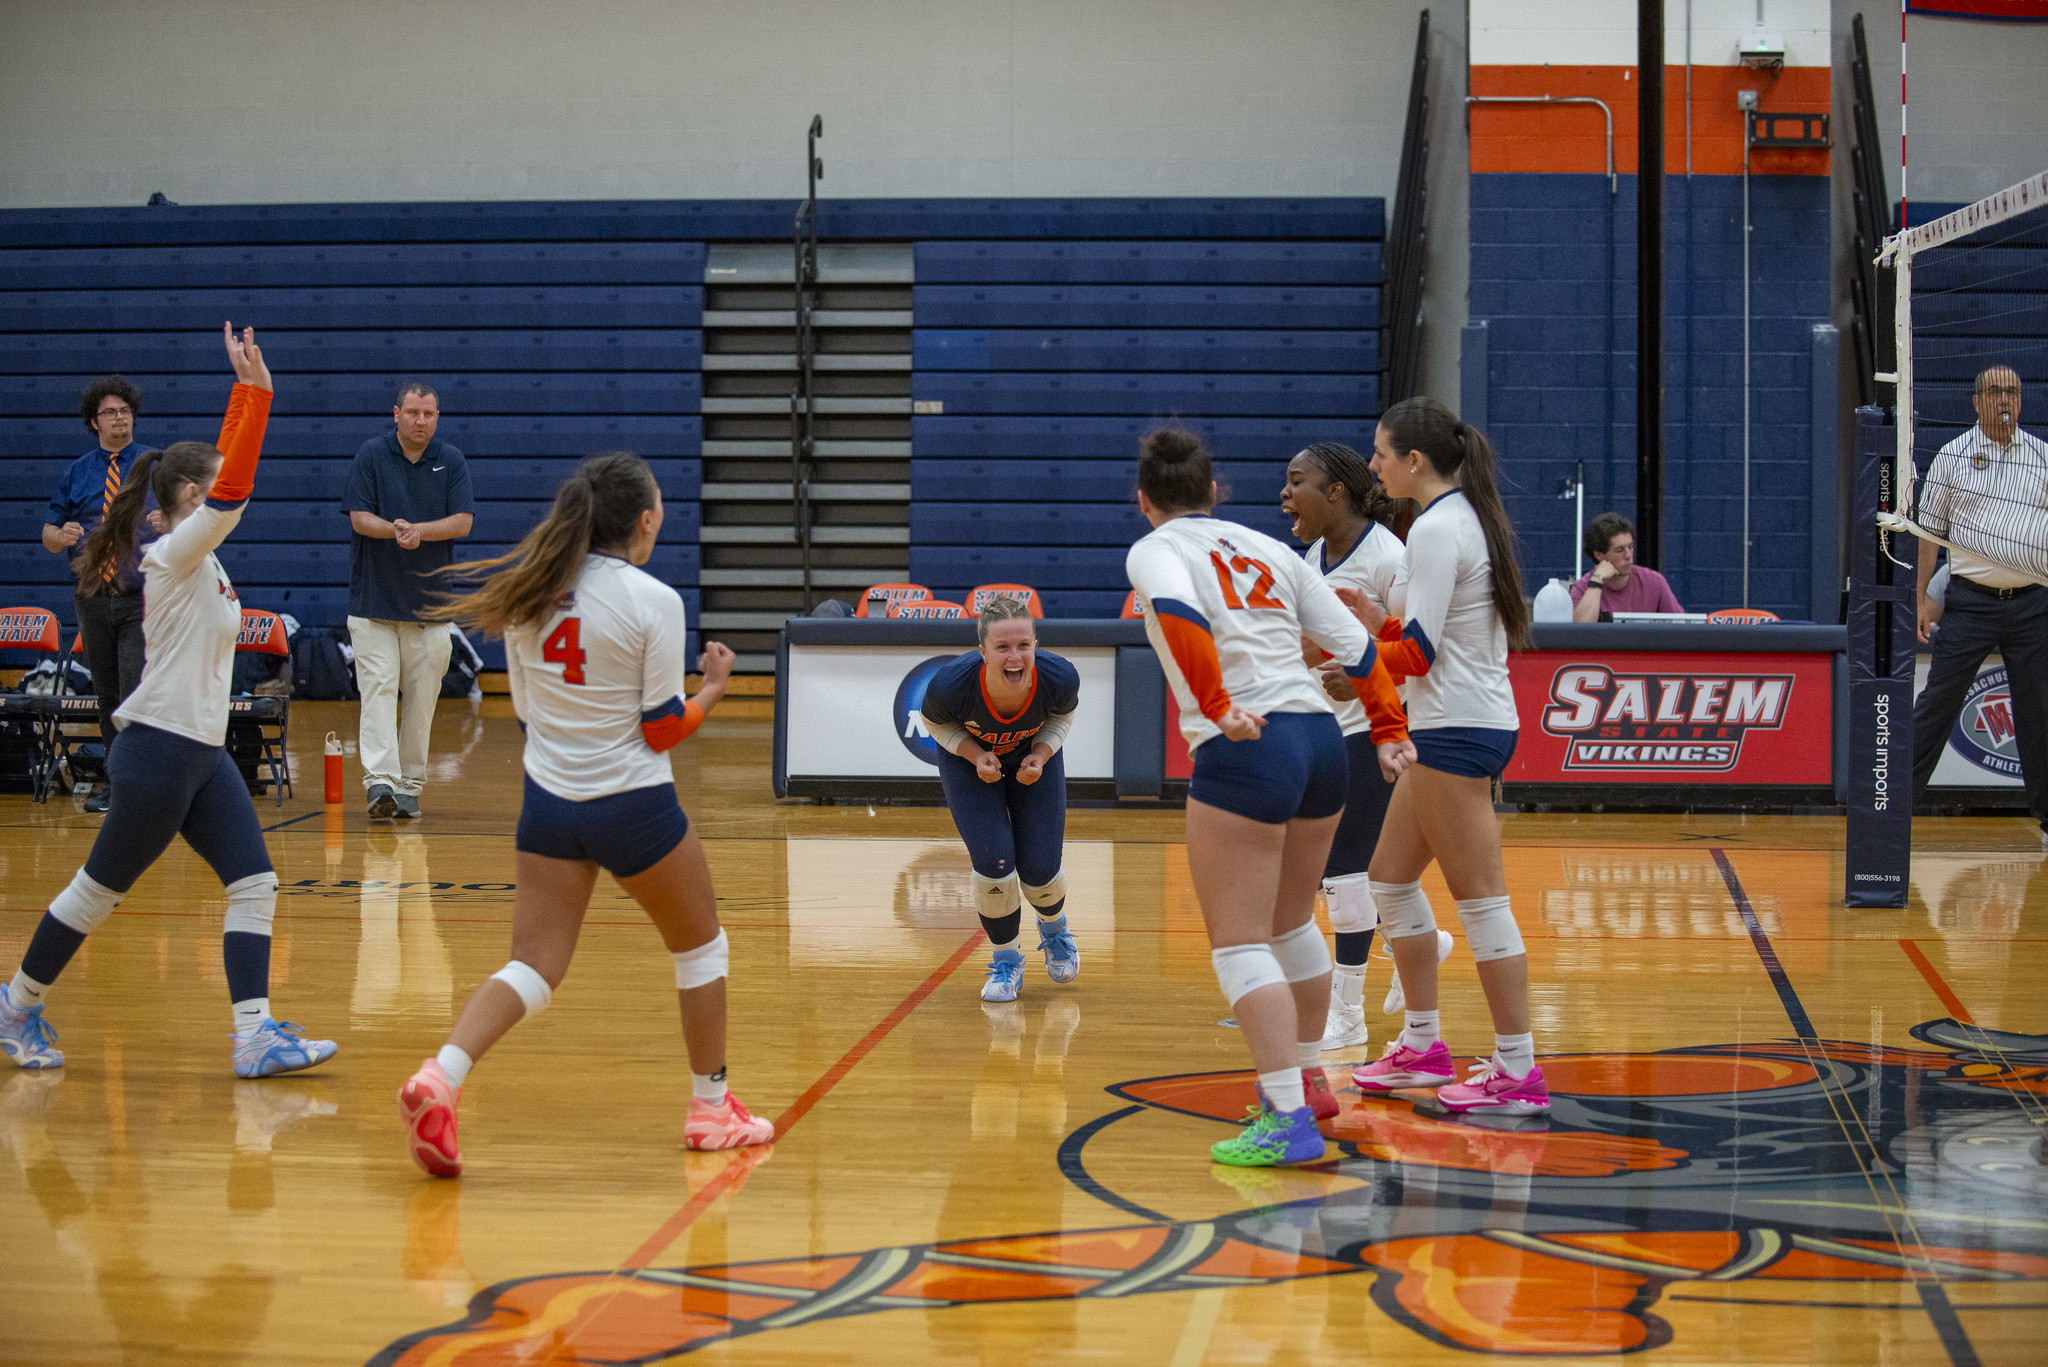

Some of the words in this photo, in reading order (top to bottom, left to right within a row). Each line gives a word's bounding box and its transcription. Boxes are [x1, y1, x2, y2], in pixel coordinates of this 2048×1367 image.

[1879, 462, 1891, 502] sports
[1210, 550, 1287, 610] 12
[869, 588, 927, 601] SALEM
[898, 606, 962, 619] SALEM
[0, 613, 51, 628] ALEM
[0, 627, 44, 642] TATE
[235, 630, 271, 644] ATE
[542, 617, 586, 685] 4
[60, 699, 100, 709] VIKIN
[1548, 670, 1788, 730] SALEM
[1873, 694, 1891, 746] sports
[1599, 726, 1736, 738] STATE
[1576, 744, 1732, 763] VIKINGS
[1982, 755, 2023, 774] ATHLET
[1854, 873, 1901, 883] (800)556-3198
